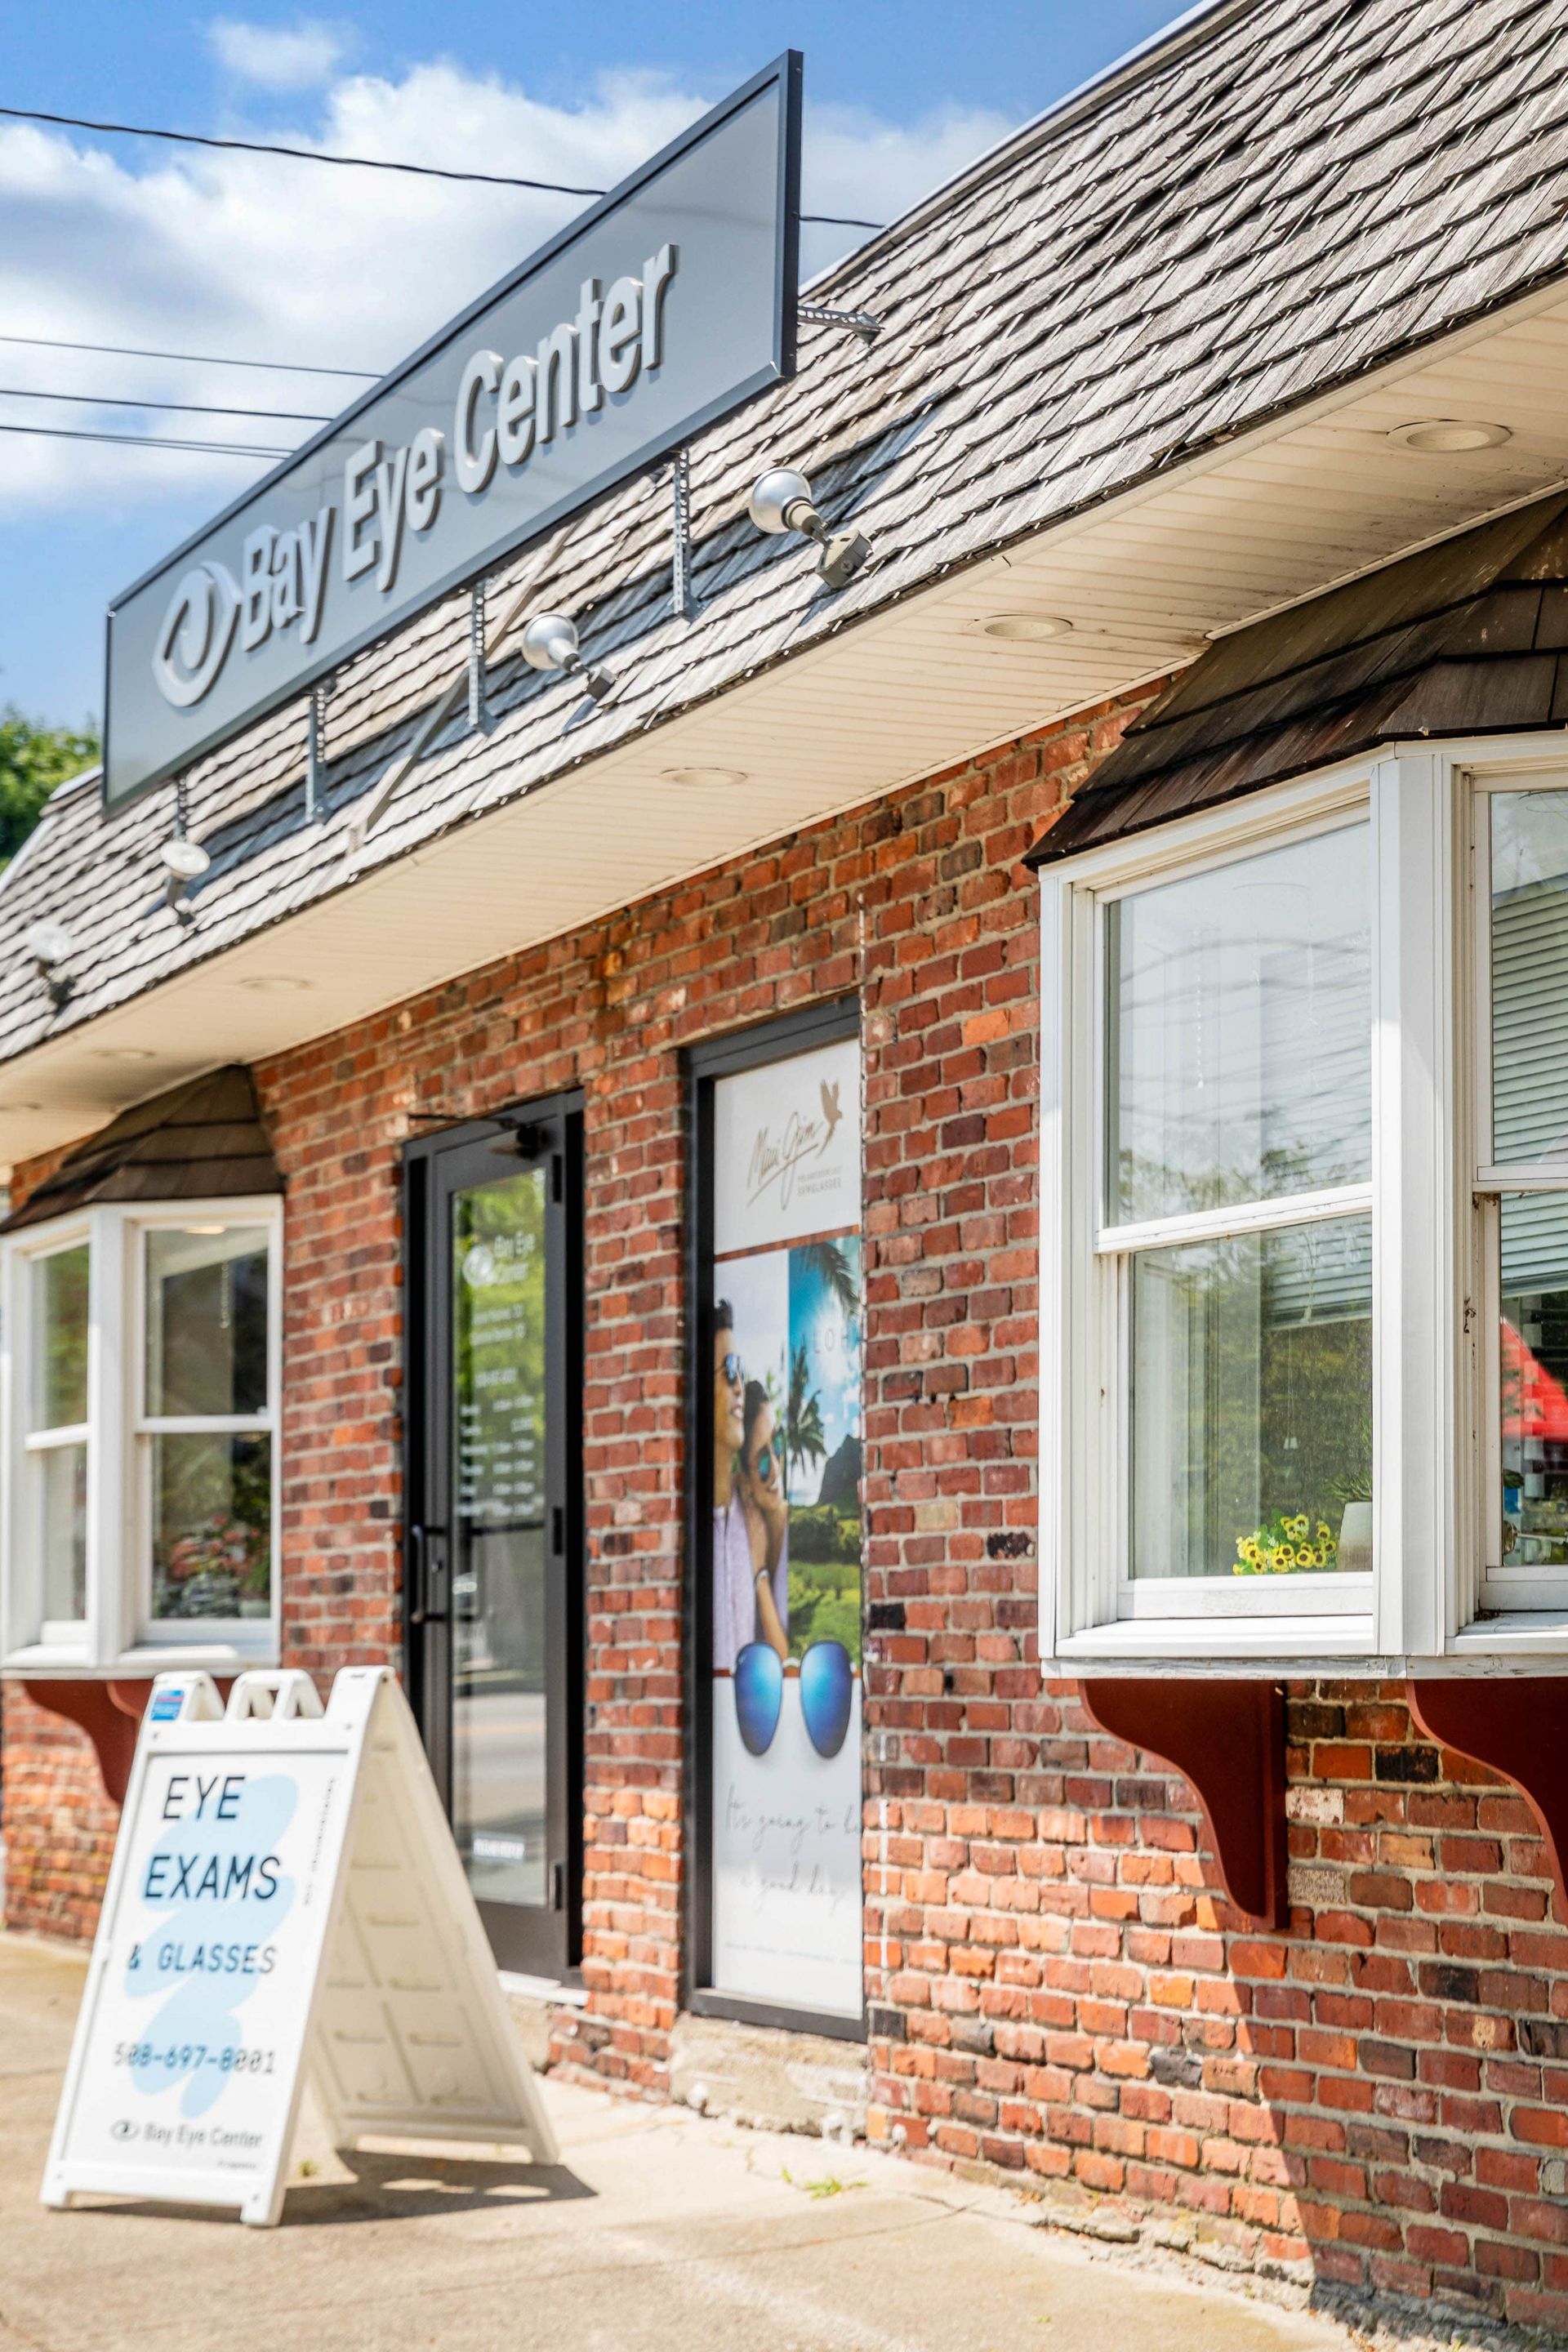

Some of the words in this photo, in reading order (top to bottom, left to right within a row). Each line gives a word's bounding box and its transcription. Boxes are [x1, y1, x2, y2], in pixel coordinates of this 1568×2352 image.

[243, 506, 336, 651] Bay
[342, 428, 445, 593] Eye
[454, 243, 679, 494] Center
[163, 1776, 246, 1820] EYE
[145, 1855, 281, 1900] EXAMS
[127, 1944, 142, 1971] &
[158, 1943, 277, 1975] GLASSES
[113, 2042, 276, 2074] 508-697-8001
[144, 2123, 172, 2148] Bay
[176, 2125, 205, 2149] Eye
[210, 2128, 263, 2149] Center
